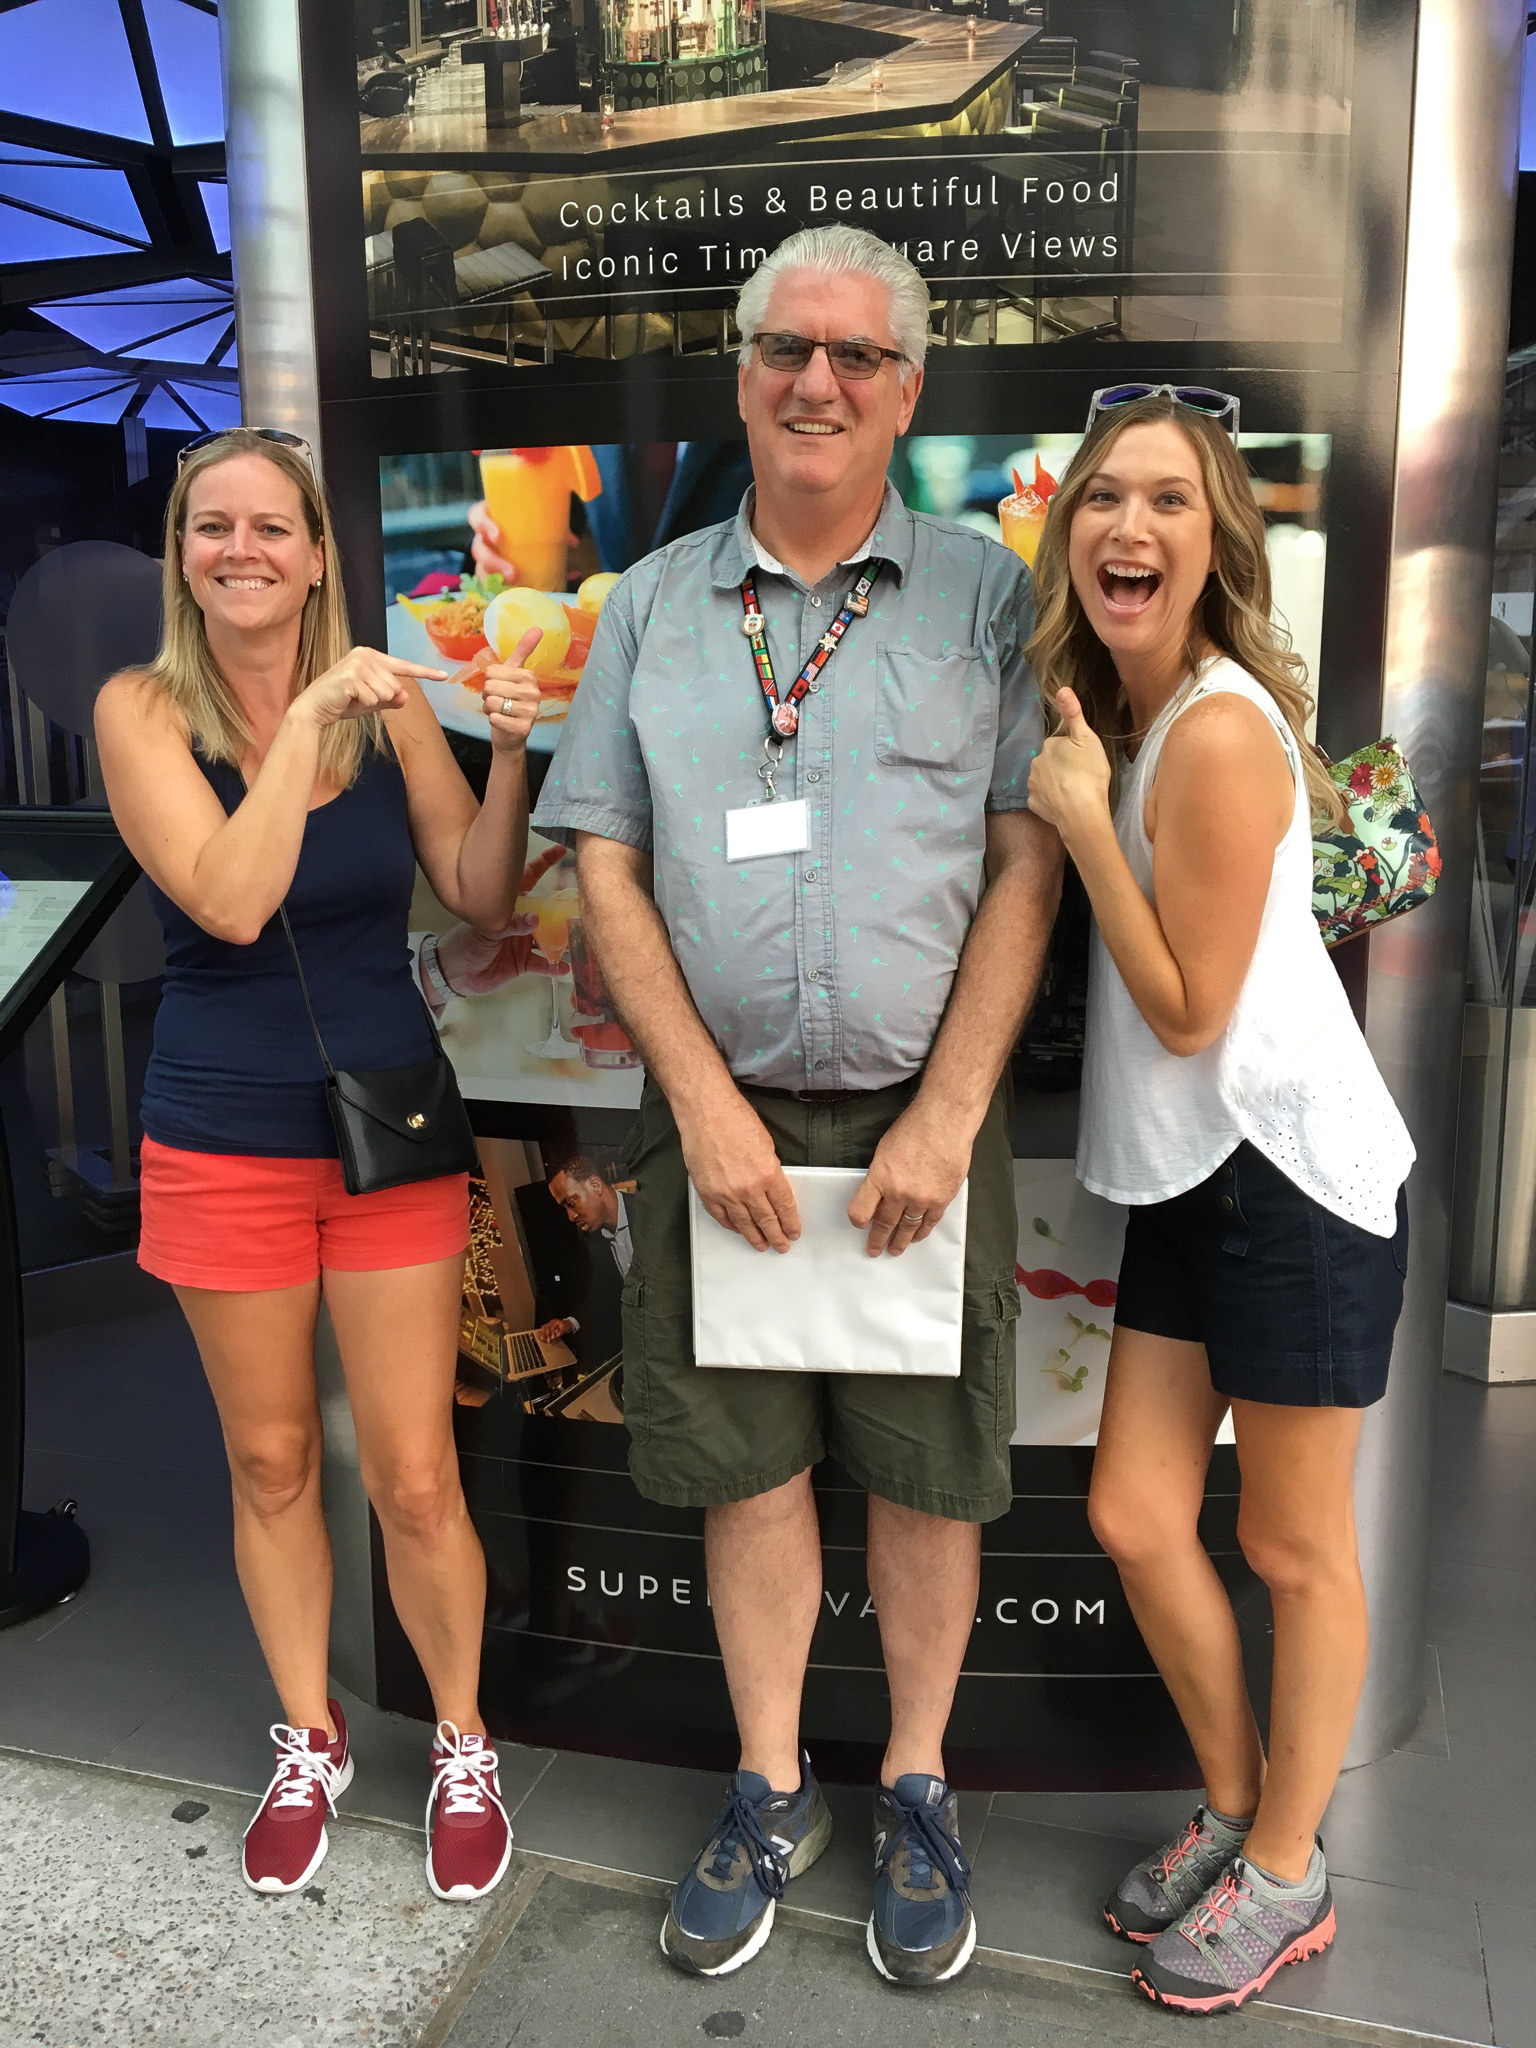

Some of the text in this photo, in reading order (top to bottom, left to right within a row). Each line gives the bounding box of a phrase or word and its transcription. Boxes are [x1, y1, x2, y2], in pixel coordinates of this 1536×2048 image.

[560, 172, 1119, 228] Cocktails & Beautiful Food
[562, 246, 679, 281] Iconic
[698, 241, 767, 271] Tim
[1001, 230, 1118, 259] Views
